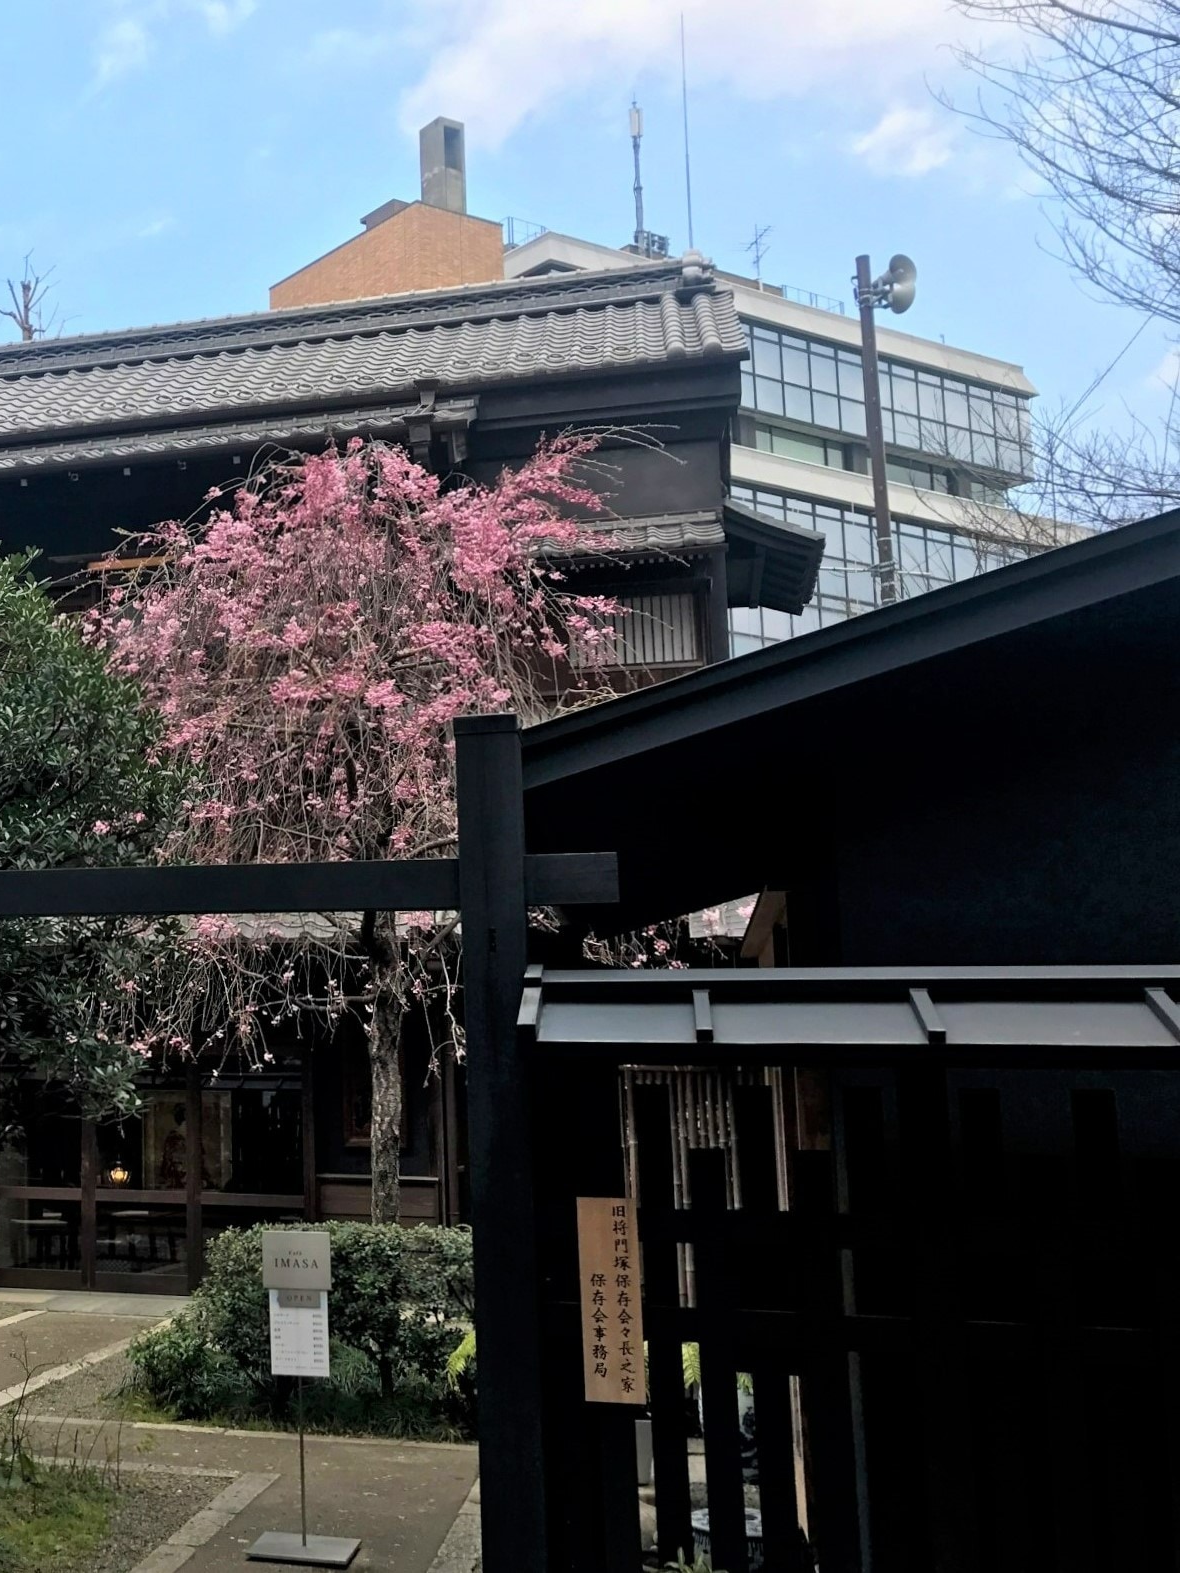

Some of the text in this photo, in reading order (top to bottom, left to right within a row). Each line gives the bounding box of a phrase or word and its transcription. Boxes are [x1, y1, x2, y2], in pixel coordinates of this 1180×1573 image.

[274, 1258, 319, 1269] IMASA
[612, 1206, 636, 1393] 旧将門塚保存会々長之家
[590, 1273, 609, 1378] 保存会事務局
